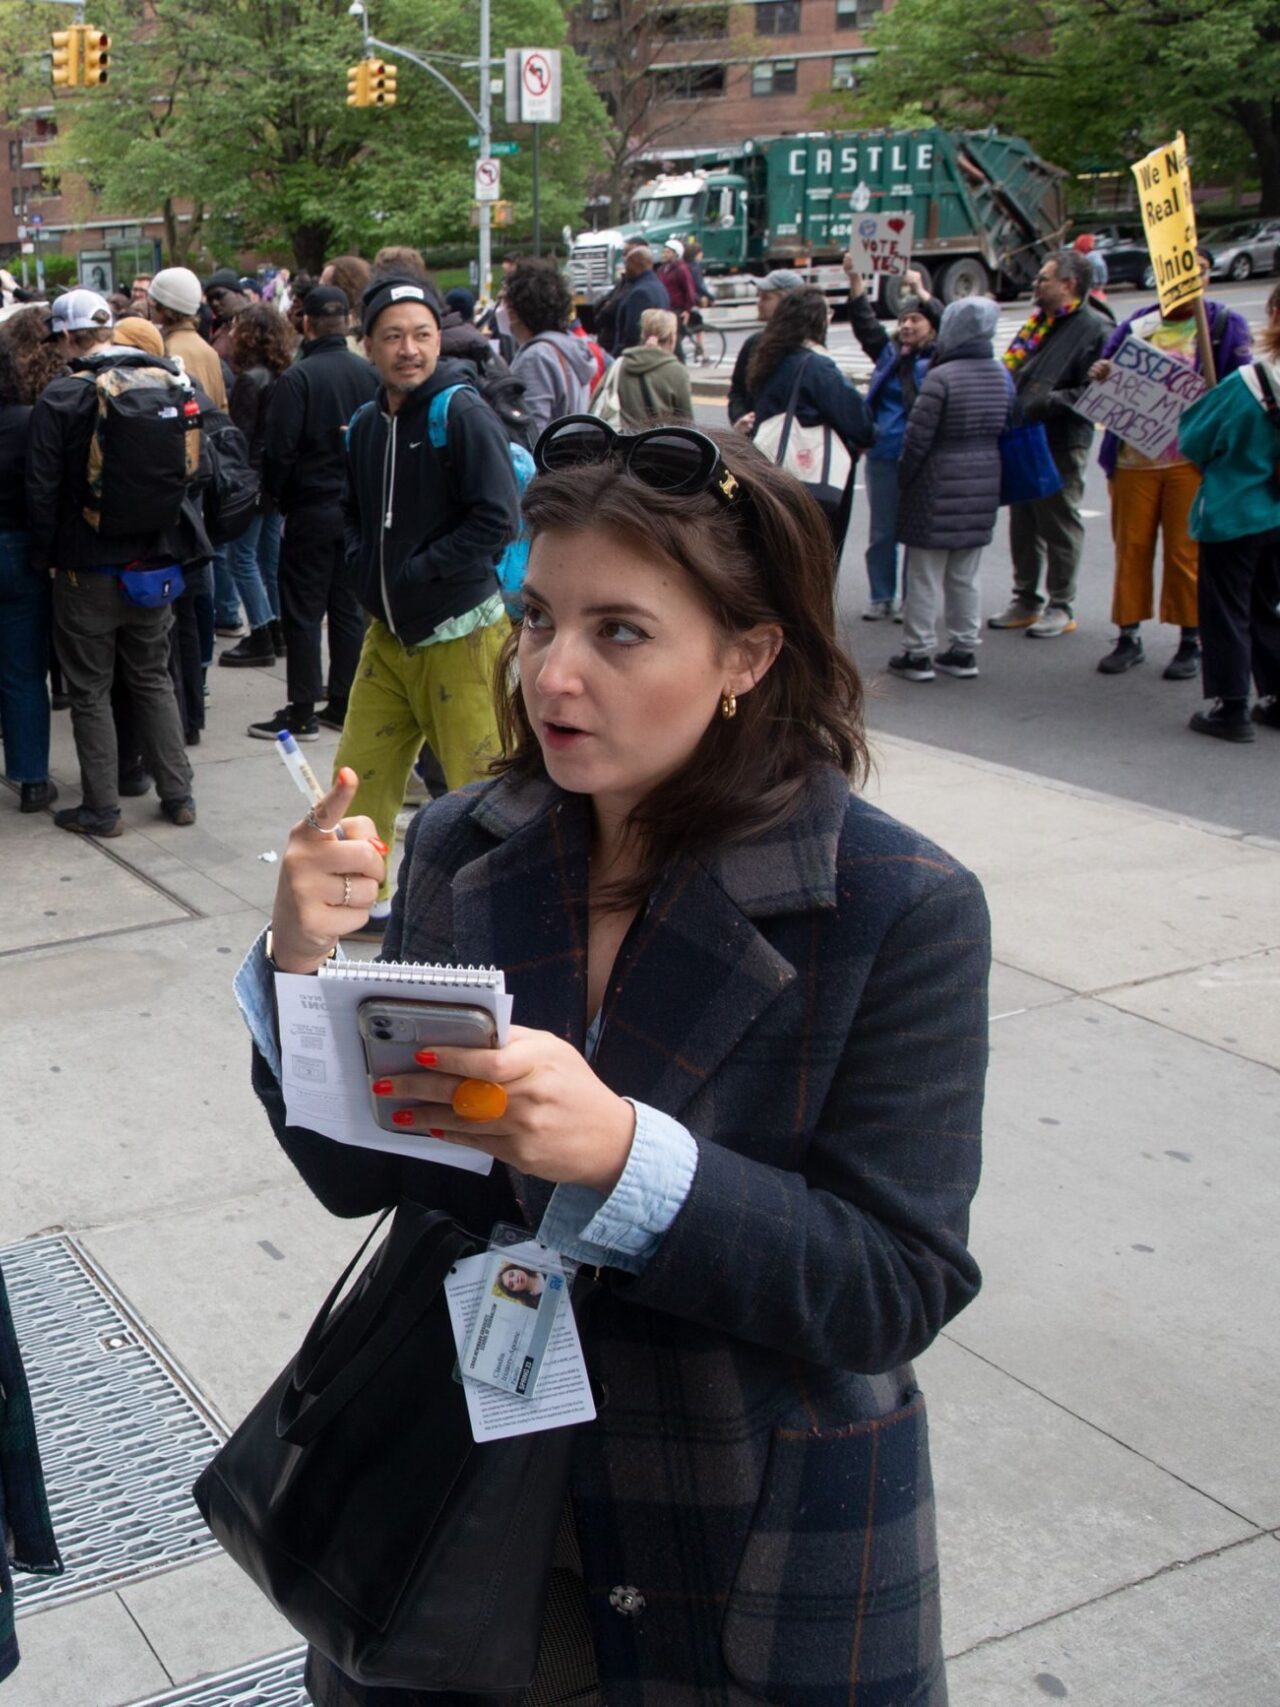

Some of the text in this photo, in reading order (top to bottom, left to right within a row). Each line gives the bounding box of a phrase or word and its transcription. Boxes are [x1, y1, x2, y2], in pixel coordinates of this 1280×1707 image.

[789, 144, 933, 175] CASTLE
[1139, 163, 1160, 191] We
[1146, 187, 1180, 227] Real
[862, 238, 899, 256] VOTE
[1110, 370, 1154, 407] ARE
[1076, 386, 1171, 450] HEROES!!
